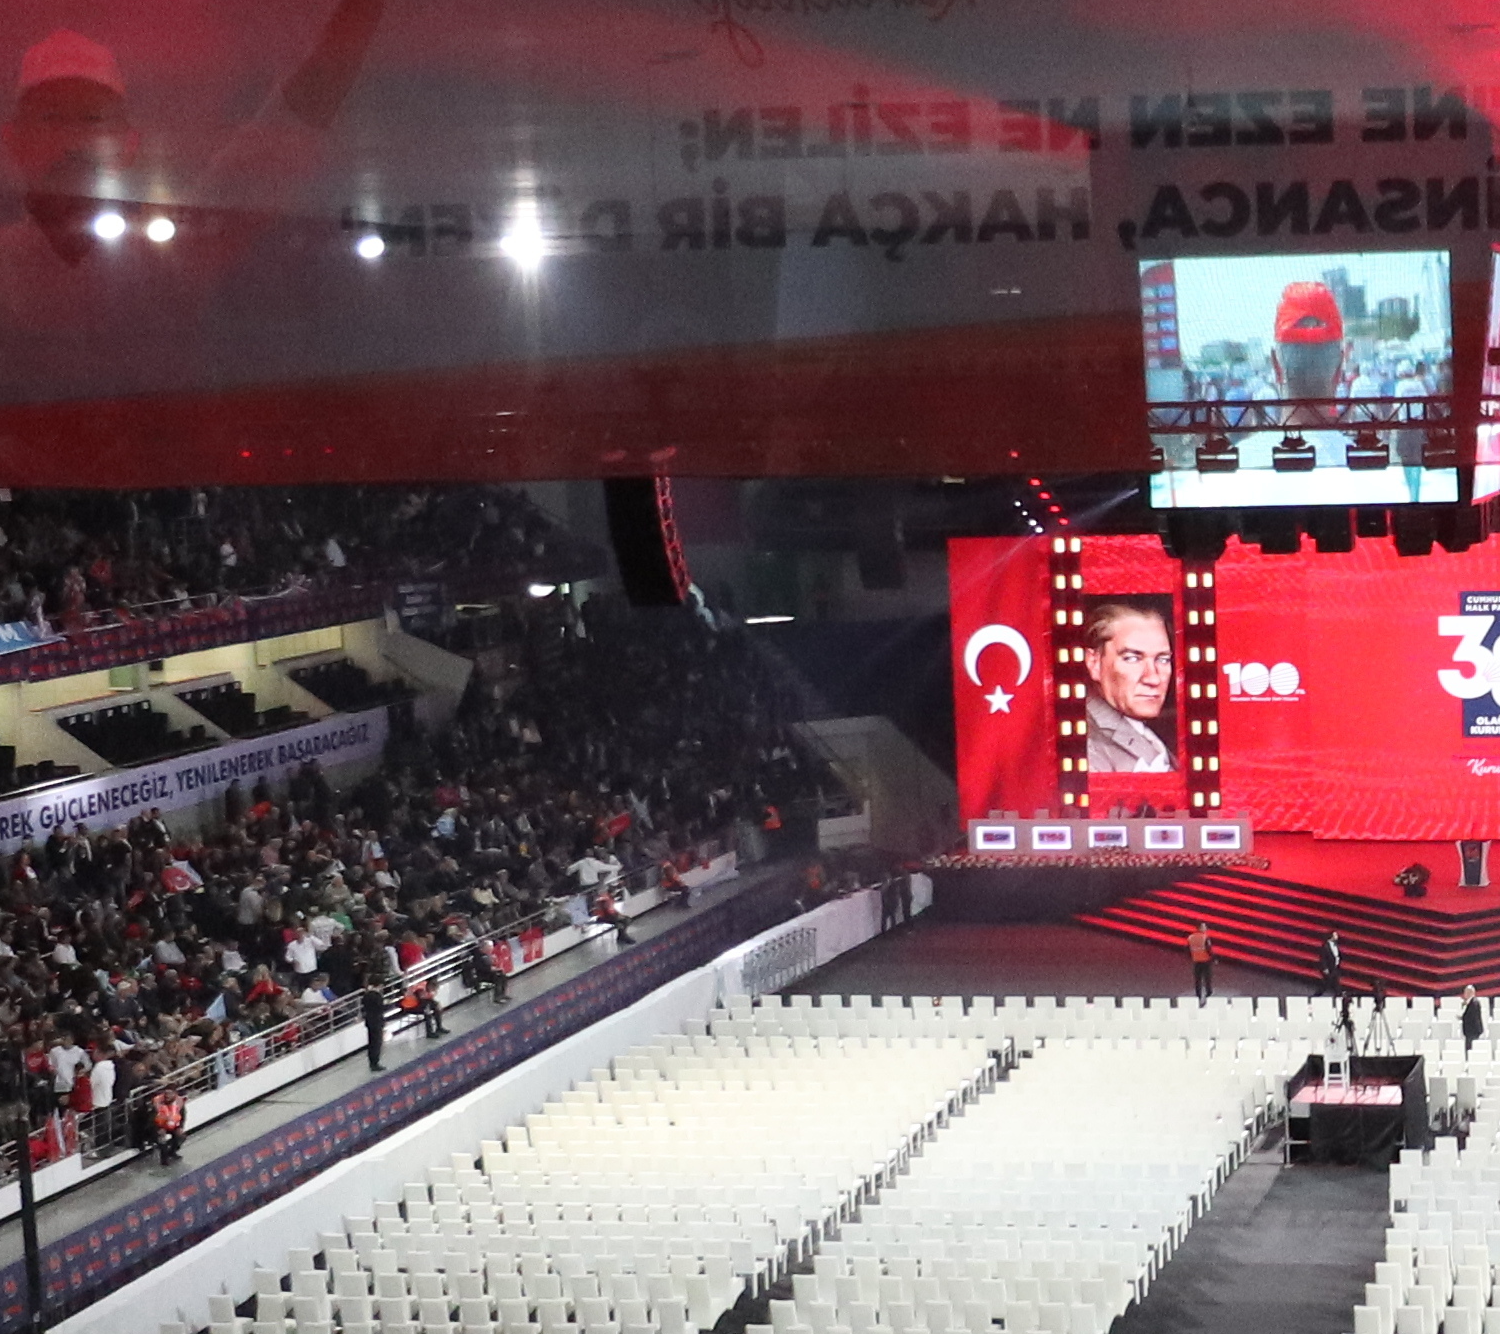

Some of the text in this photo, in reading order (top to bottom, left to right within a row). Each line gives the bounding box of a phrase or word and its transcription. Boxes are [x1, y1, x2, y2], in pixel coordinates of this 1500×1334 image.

[1465, 603, 1490, 612] HALK
[39, 770, 174, 837] GÜÇLENECEĞİZ,
[174, 745, 275, 794] YENİLENEREK
[276, 719, 372, 765] BAŞARACAĞIZ
